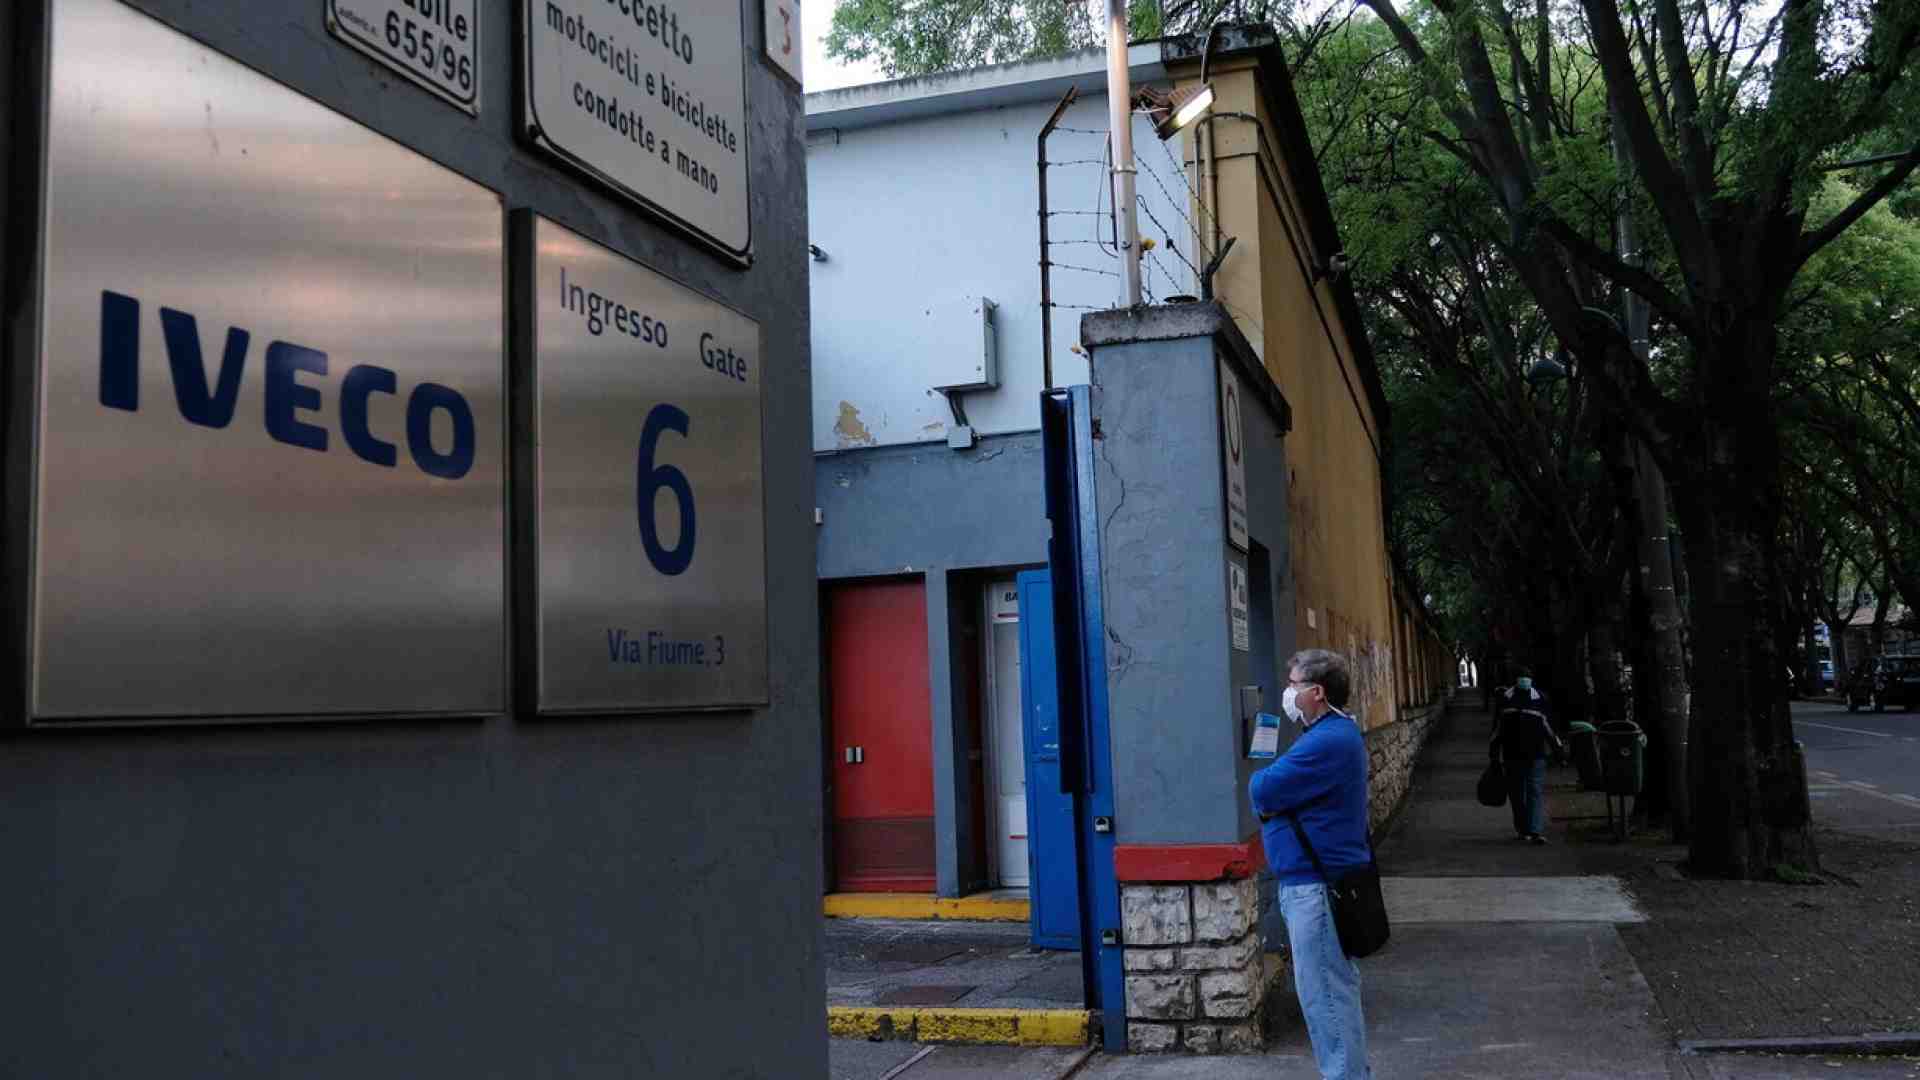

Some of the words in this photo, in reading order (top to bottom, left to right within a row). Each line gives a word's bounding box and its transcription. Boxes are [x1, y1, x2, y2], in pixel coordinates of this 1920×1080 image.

[386, 10, 472, 90] 655/96
[546, 1, 639, 86] motocicli
[645, 72, 656, 96] e
[660, 72, 737, 153] biciclette
[607, 0, 693, 65] cetto
[573, 82, 655, 152] condotte
[660, 139, 671, 165] a
[676, 149, 719, 195] mano
[560, 266, 669, 348] Ingresso
[700, 332, 747, 382] Gate
[99, 289, 476, 480] IVECO
[637, 403, 696, 576] 6
[607, 628, 640, 663] Via
[714, 634, 725, 666] 3
